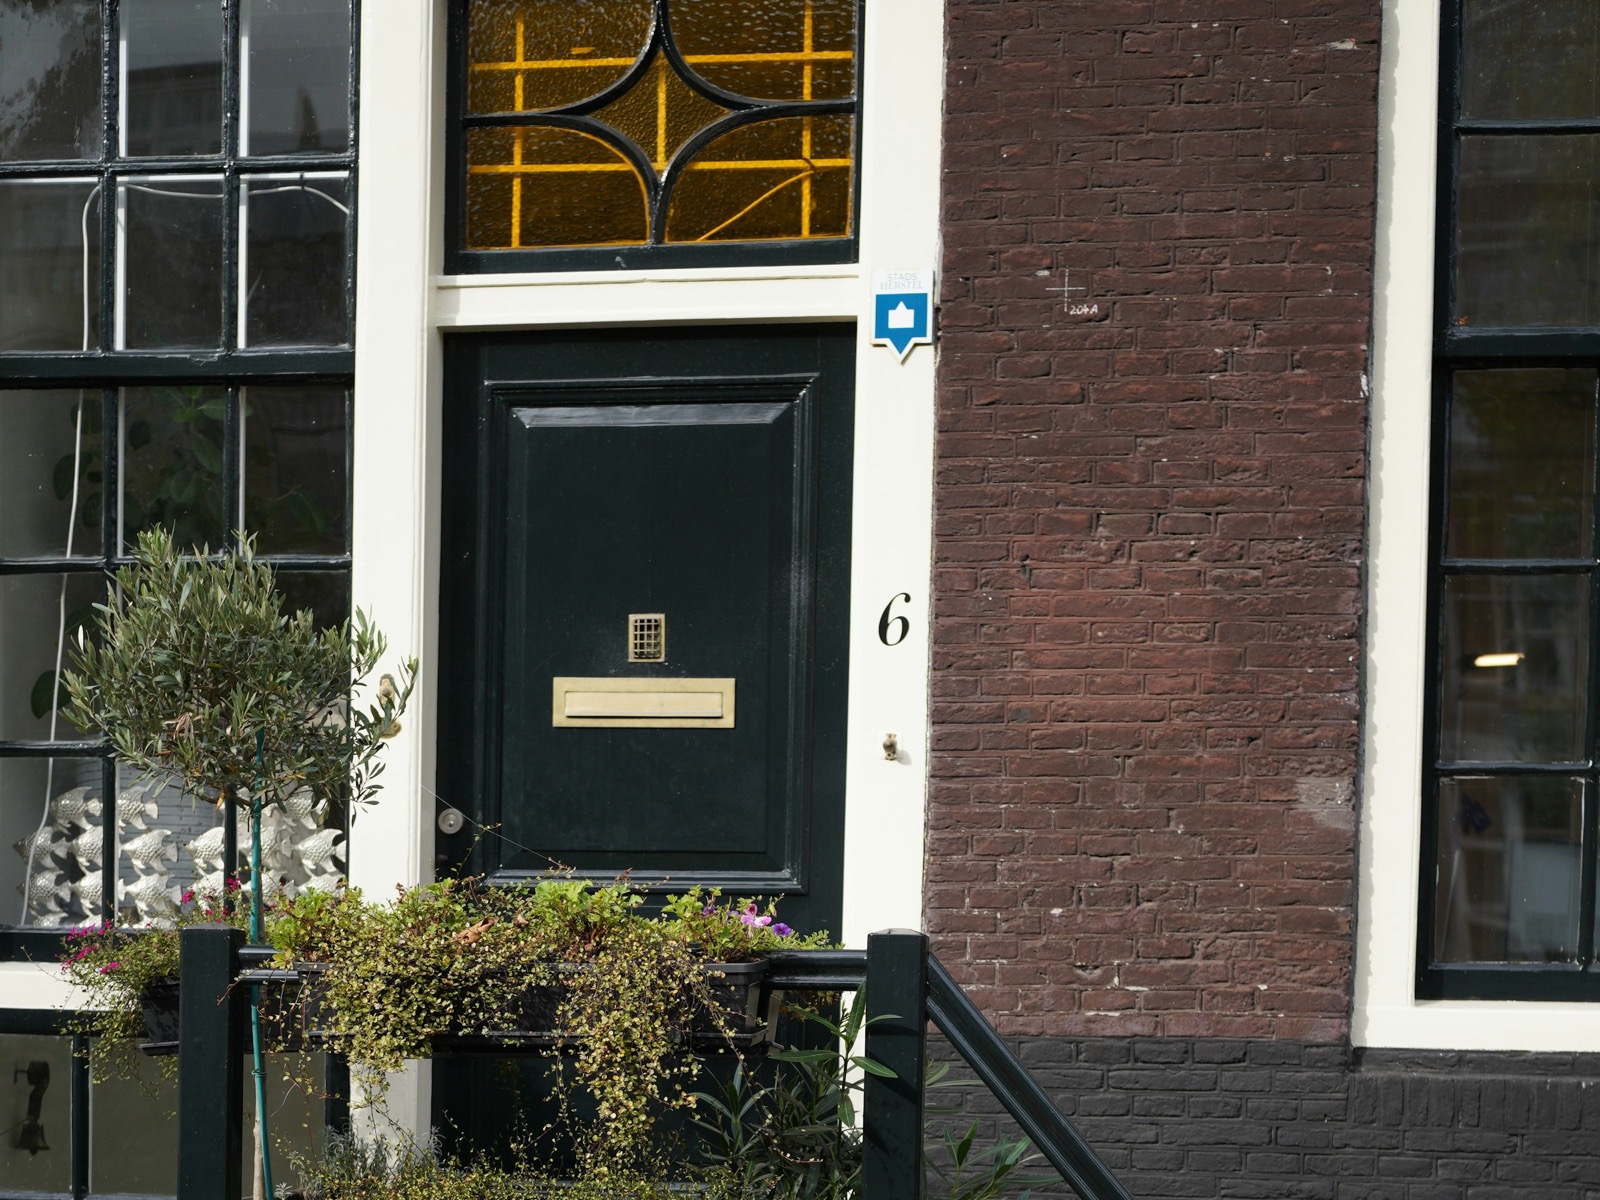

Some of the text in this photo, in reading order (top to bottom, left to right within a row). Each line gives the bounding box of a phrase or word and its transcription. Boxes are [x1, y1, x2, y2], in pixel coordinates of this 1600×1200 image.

[887, 273, 918, 282] STADS
[880, 281, 925, 290] HERSTEL
[878, 592, 911, 646] 6
